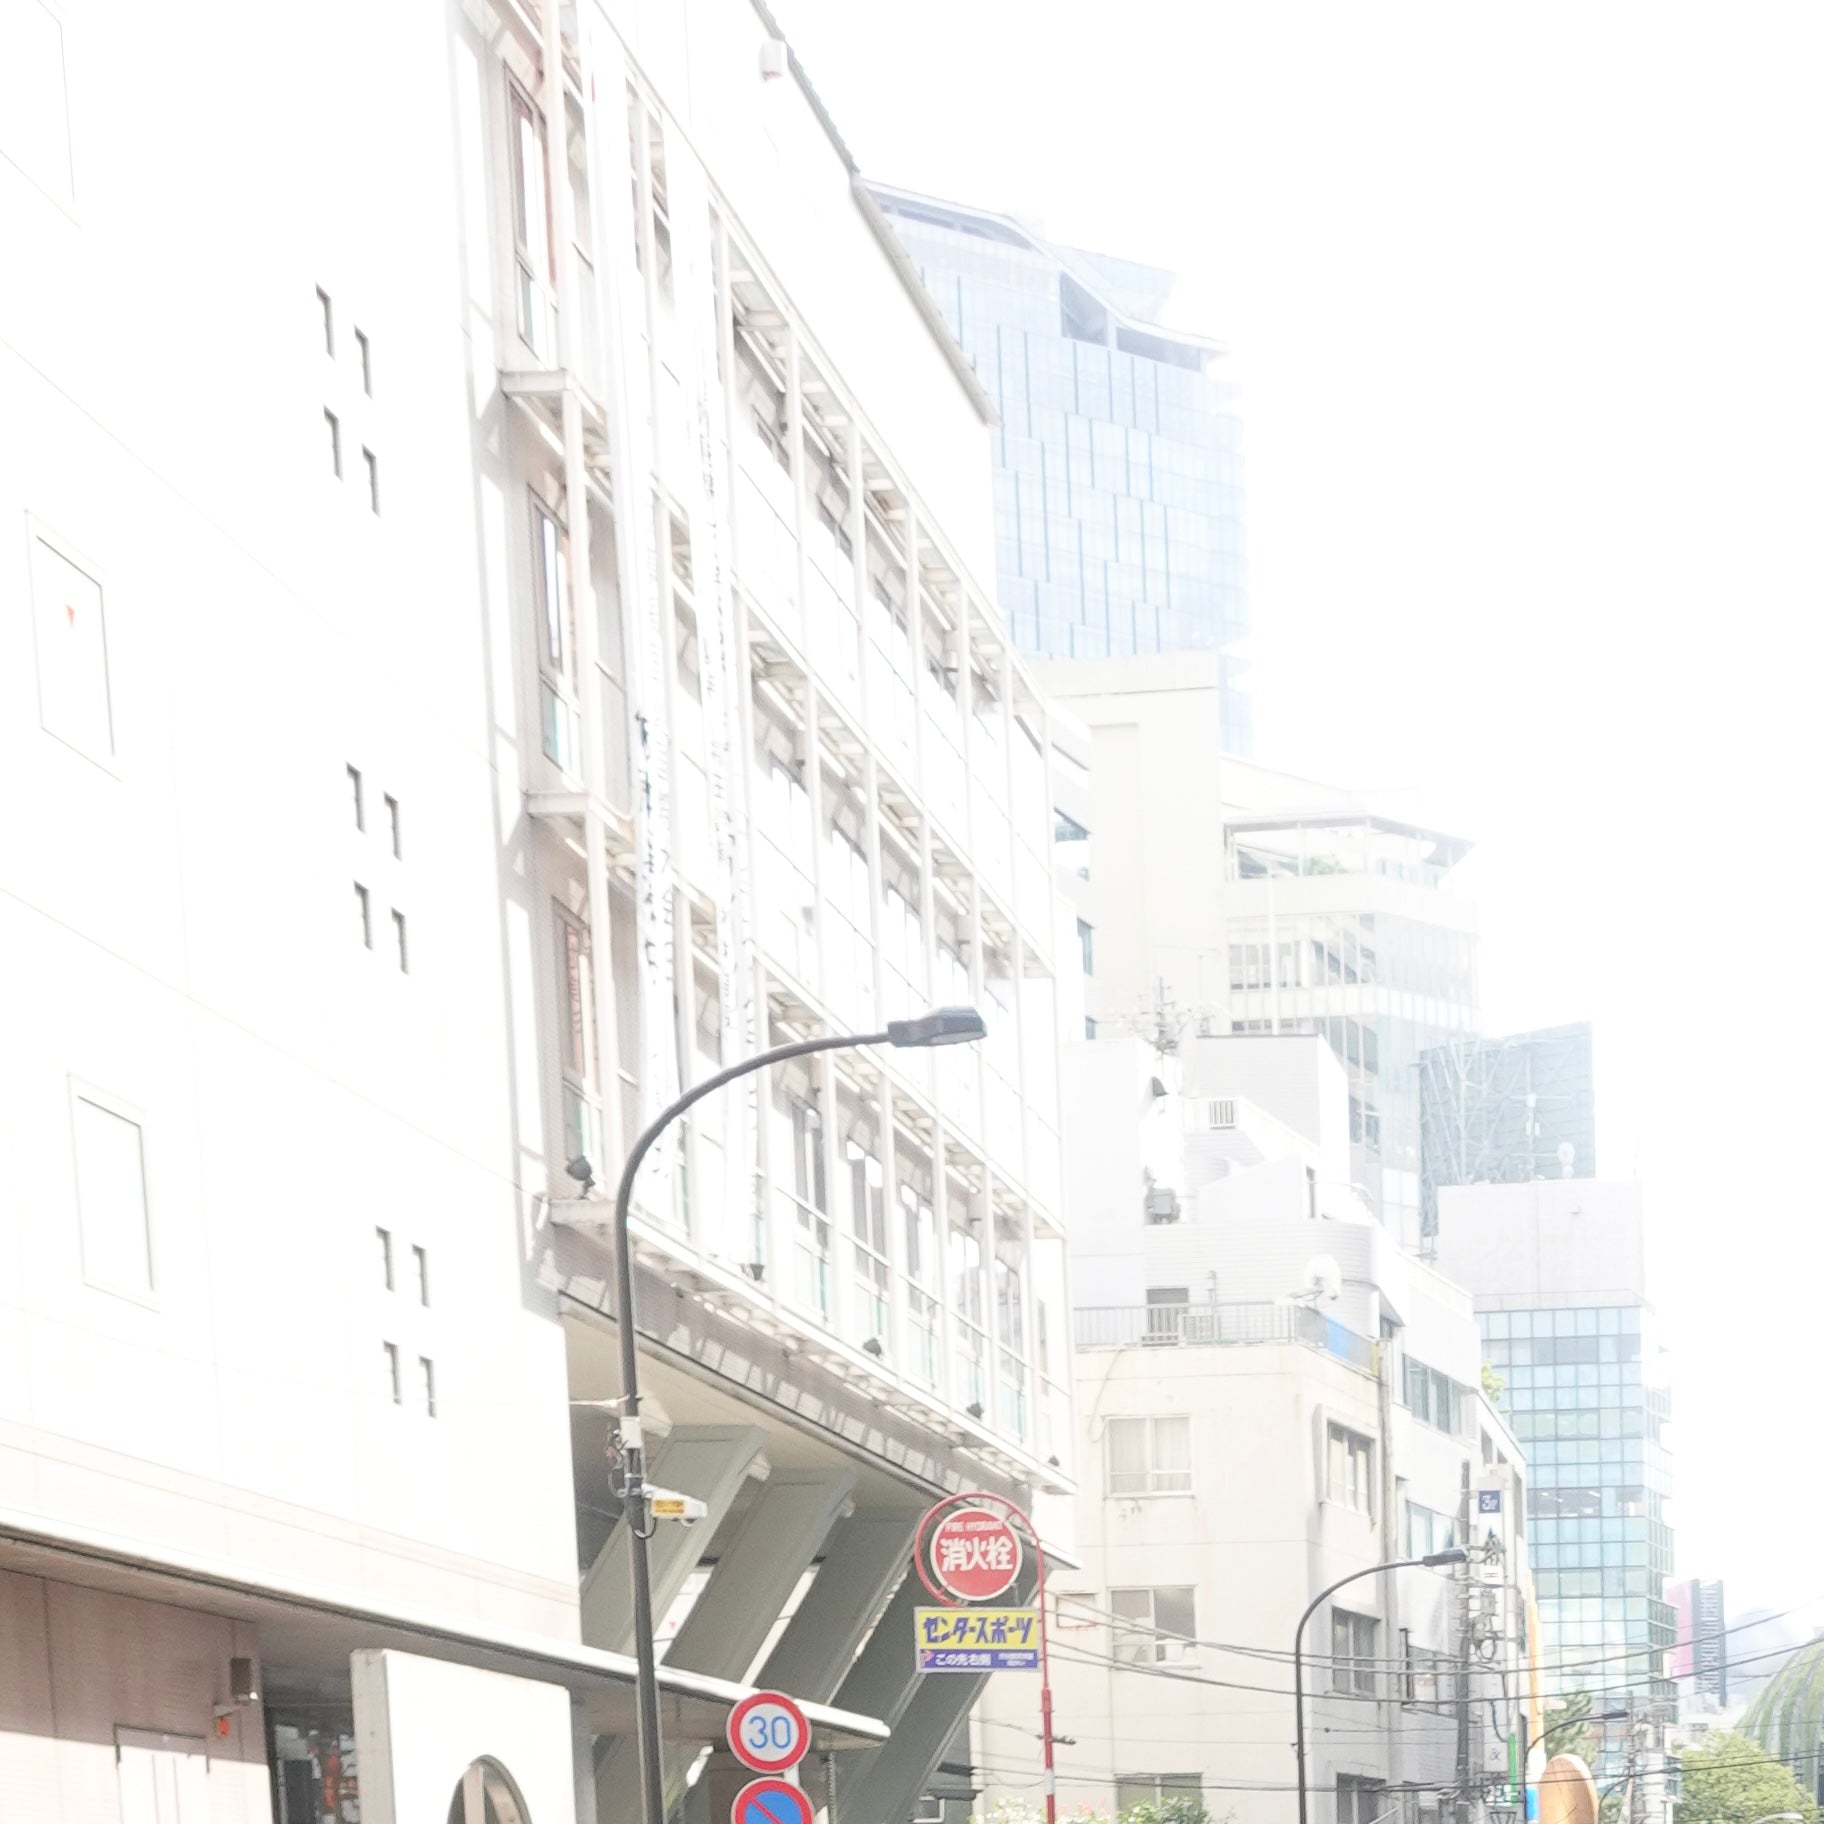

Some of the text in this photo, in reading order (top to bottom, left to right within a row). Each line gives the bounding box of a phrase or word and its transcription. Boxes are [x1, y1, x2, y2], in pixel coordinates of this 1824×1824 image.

[940, 1536, 1013, 1572] 消火栓
[923, 1616, 1033, 1643] センタースポーツ
[749, 1716, 791, 1749] 30
